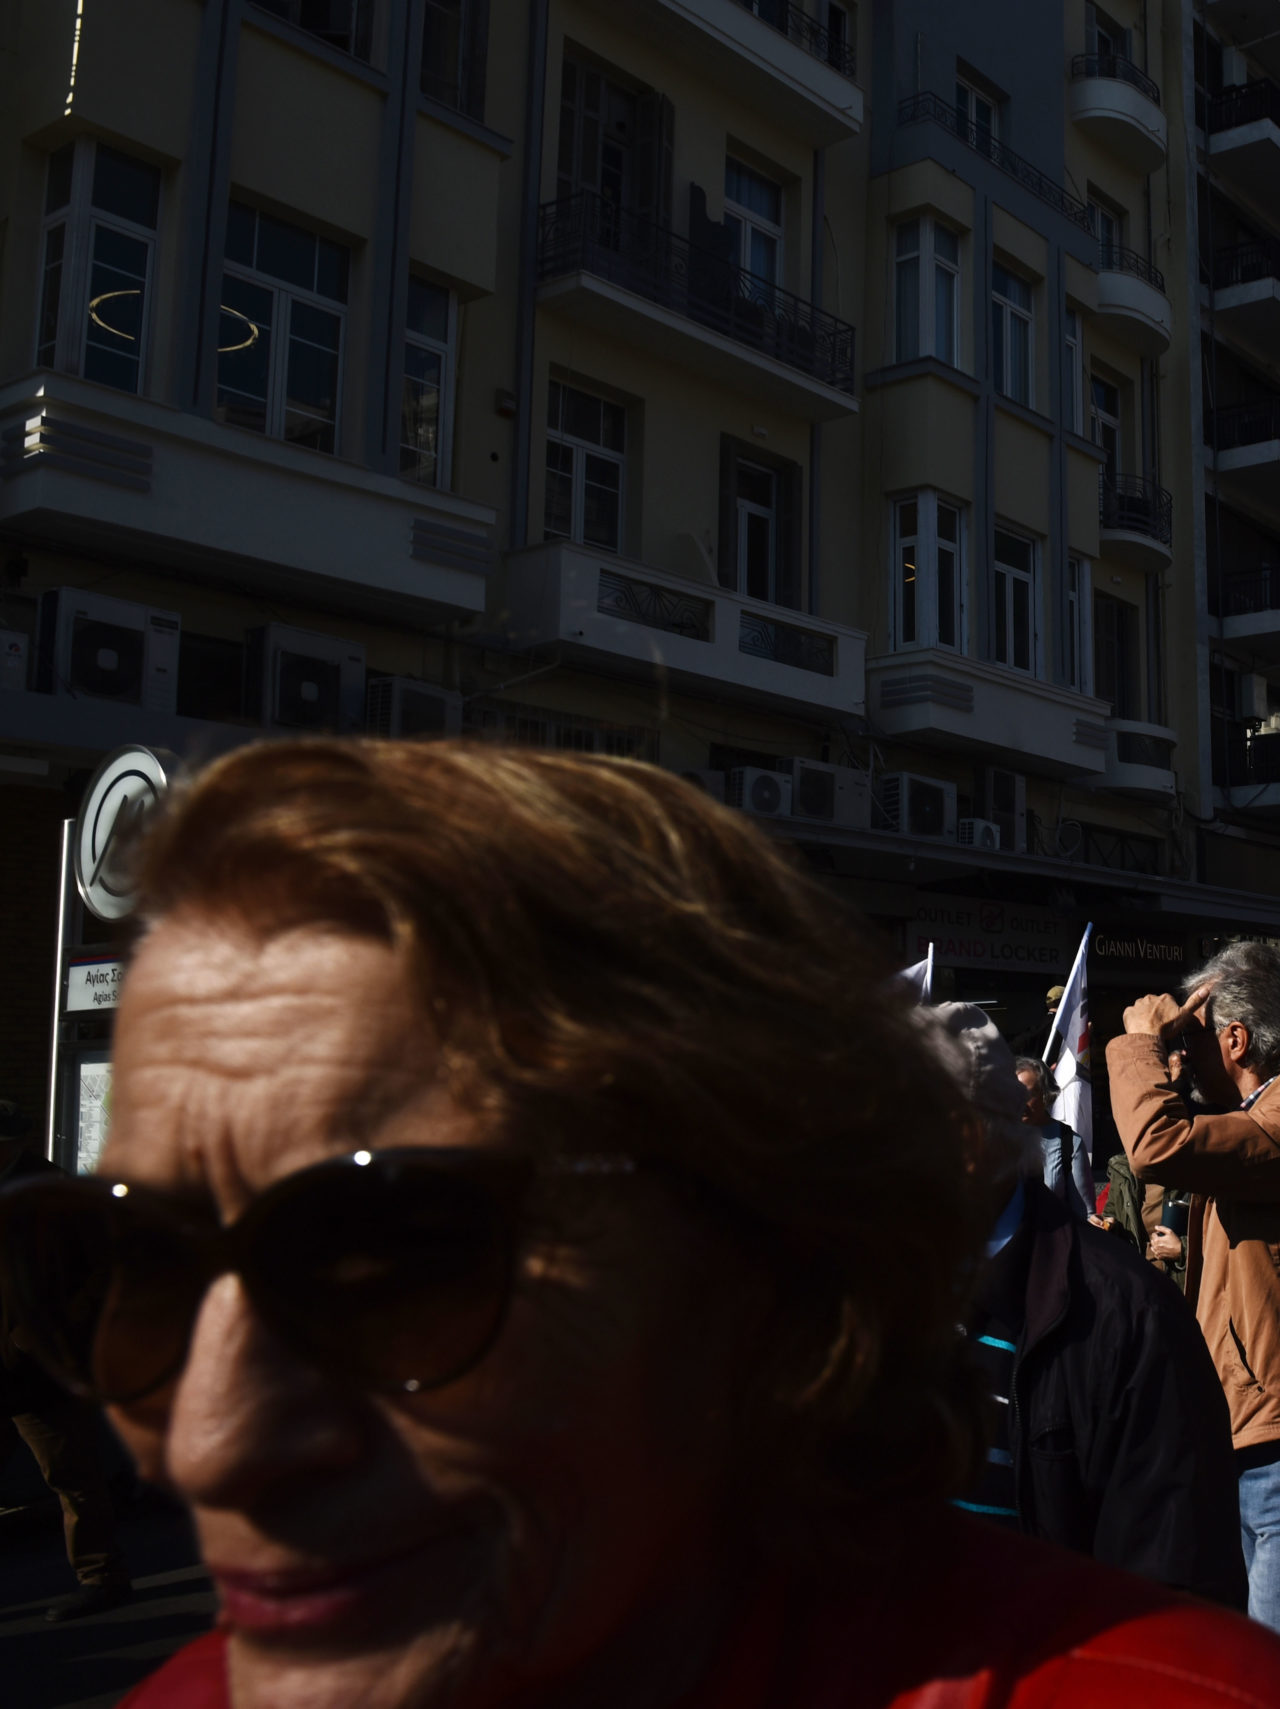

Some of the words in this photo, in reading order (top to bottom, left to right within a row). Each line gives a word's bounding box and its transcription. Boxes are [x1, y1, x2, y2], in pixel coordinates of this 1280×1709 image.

[916, 907, 973, 927] OUTLET
[1010, 917, 1060, 935] OUTLET
[917, 935, 986, 958] BRAND
[990, 943, 1060, 964] LOCKER
[1095, 935, 1136, 958] GIANNI
[1137, 939, 1184, 961] VENTURI
[85, 968, 110, 988] Αγίας
[93, 991, 111, 1005] Agias
